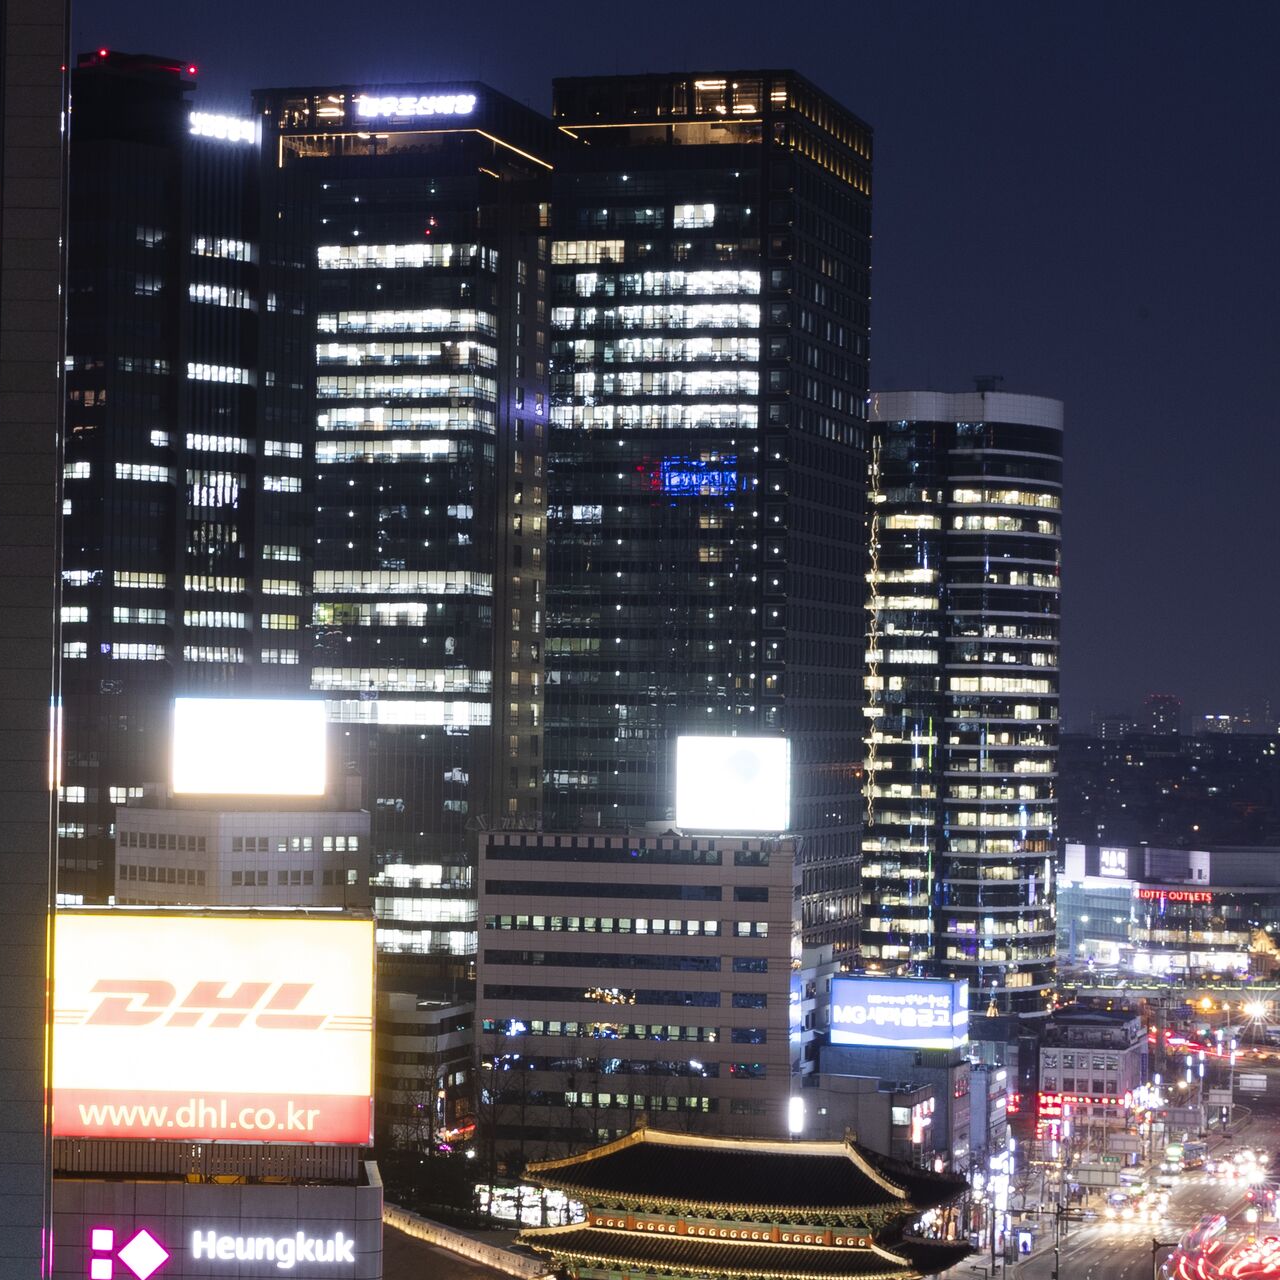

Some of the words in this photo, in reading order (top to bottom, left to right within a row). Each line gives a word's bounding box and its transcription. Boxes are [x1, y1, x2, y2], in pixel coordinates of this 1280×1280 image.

[1140, 890, 1166, 900] LOTTE
[1168, 891, 1212, 902] OUTLETS
[84, 979, 332, 1031] DHL
[77, 1096, 321, 1133] www.dhl.co.kr
[191, 1230, 356, 1270] Heungkuk
